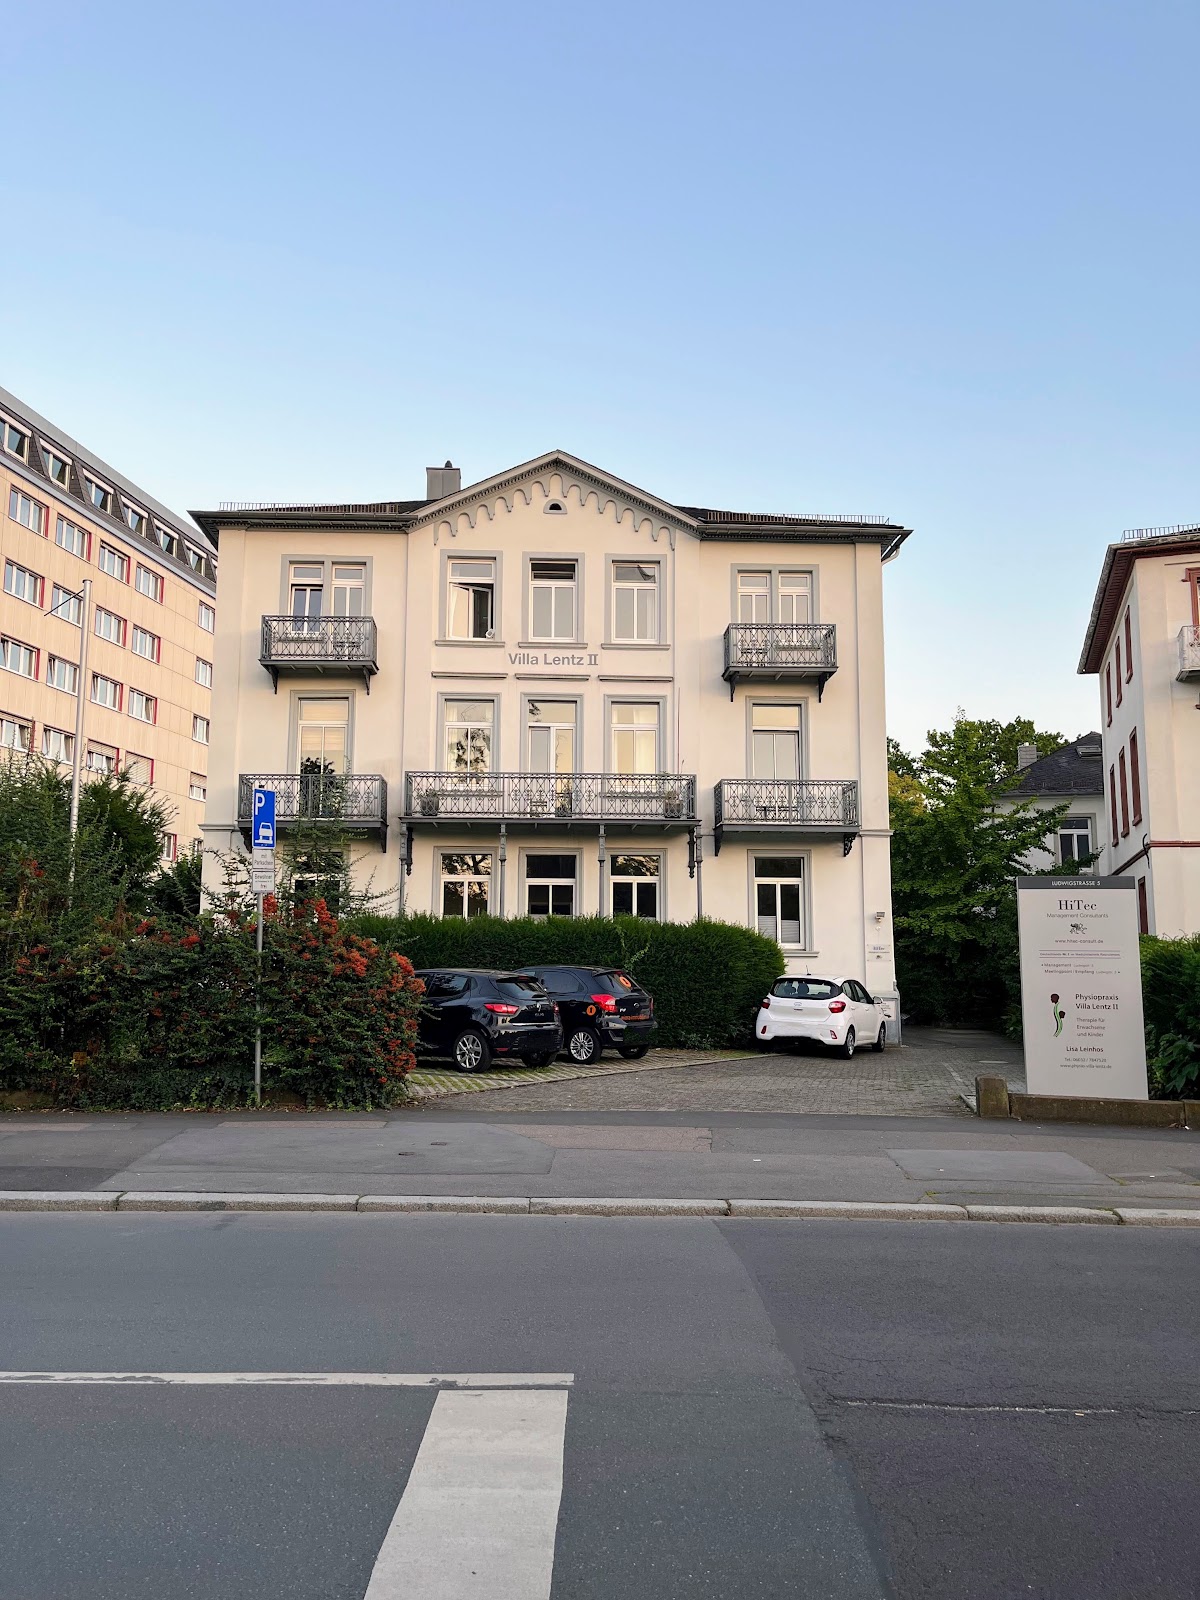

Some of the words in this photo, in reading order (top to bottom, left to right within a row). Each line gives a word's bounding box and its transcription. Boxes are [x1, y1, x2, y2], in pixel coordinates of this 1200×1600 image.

[508, 653, 538, 665] Villa
[544, 653, 584, 665] Lentz
[587, 653, 599, 665] II
[255, 793, 265, 815] P
[1058, 899, 1097, 911] HiTec
